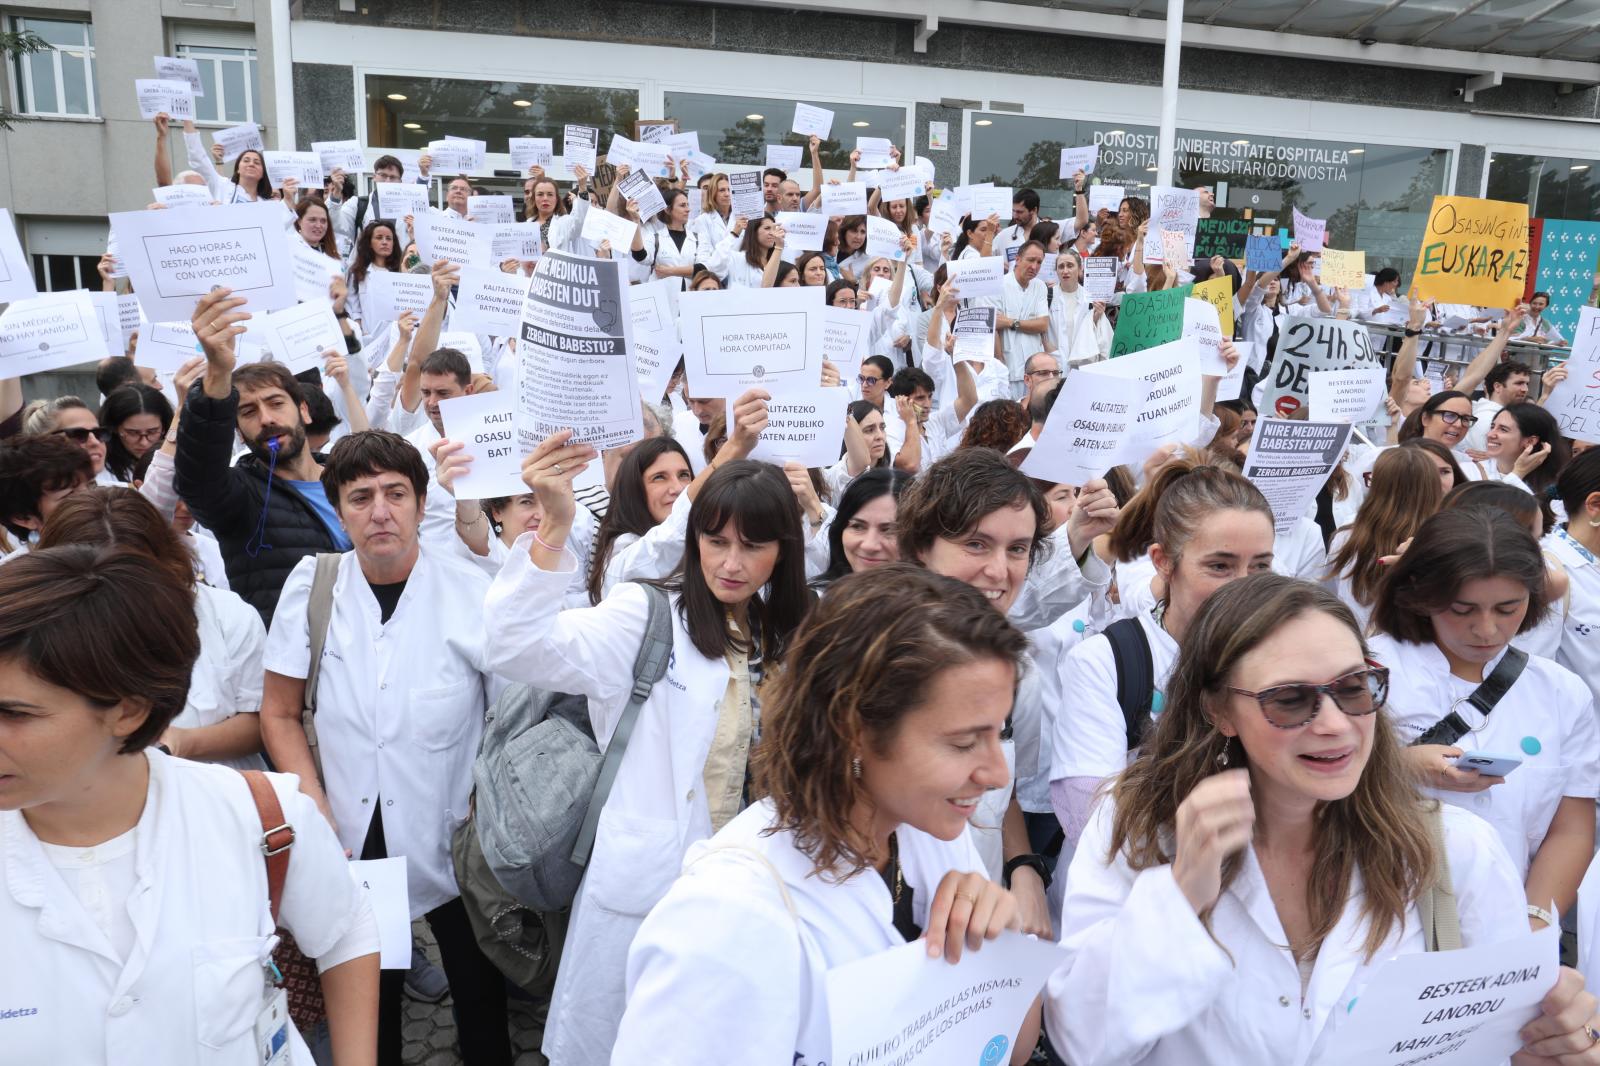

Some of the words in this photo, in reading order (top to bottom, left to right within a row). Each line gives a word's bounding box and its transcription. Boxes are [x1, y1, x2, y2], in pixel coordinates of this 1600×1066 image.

[1093, 130, 1158, 150] DONOSTI
[1276, 147, 1349, 165] OSPITALEA
[1096, 149, 1157, 168] HOSPITA
[1278, 164, 1348, 182] DONOSTIA
[431, 225, 455, 235] BESTEEK
[456, 228, 476, 238] ADINA
[433, 244, 449, 252] NAHI
[438, 236, 467, 245] LANORDU
[169, 245, 197, 256] HAGO
[199, 241, 233, 253] HORAS
[234, 241, 242, 249] A
[160, 258, 199, 270] DESTAJO
[223, 252, 257, 264] PAGAN
[1420, 240, 1527, 283] EUSKARAZ
[175, 270, 197, 281] CON
[197, 265, 248, 280] VOCACIÓN
[548, 259, 599, 286] MEDIKUA
[483, 283, 525, 296] KALITATEZKO
[475, 293, 501, 305] OSASUN
[572, 287, 601, 308] DUT
[479, 304, 500, 313] BATEN
[4, 322, 20, 332] SIN
[22, 313, 65, 329] MÉDICOS
[0, 335, 15, 345] NO
[16, 330, 35, 341] HAY
[37, 323, 79, 337] SANIDAD
[526, 326, 559, 349] ZERGATIK
[559, 336, 615, 353] BABESTU?
[722, 333, 744, 342] HORA
[745, 331, 788, 342] TRABAJADA
[720, 344, 742, 353] HORA
[743, 343, 791, 353] COMPUTADA
[1282, 322, 1347, 360] 24h
[1352, 329, 1379, 363] SO
[1328, 379, 1355, 387] BESTEEK
[1355, 378, 1372, 386] ADINA
[766, 404, 817, 414] ALITATEZKO
[787, 419, 825, 428] PUBLIKO
[1073, 419, 1106, 432] OSASUN
[1263, 423, 1291, 437] NIRE
[1291, 425, 1338, 438] MEDIKUA
[1559, 413, 1587, 433] DEL
[583, 425, 606, 437] 3AN
[787, 433, 816, 441] ALDE!!
[1073, 437, 1101, 450] BATEN
[1260, 437, 1313, 450] BABESTEN
[1313, 439, 1335, 450] DUT
[487, 446, 512, 458] BAT
[1255, 467, 1292, 477] ZERGATIK
[1291, 466, 1327, 476] BABESTU?
[1417, 978, 1488, 1001] BESTEEK
[1489, 965, 1542, 989] ADINA
[1421, 997, 1506, 1025] LANORDU
[848, 1036, 900, 1066] QUIERO
[899, 998, 951, 1044] TRABAJAR
[951, 987, 971, 1009] LAS
[971, 976, 1023, 998] MISMAS
[915, 1029, 935, 1056] QUE
[934, 1015, 954, 1039] LOS
[954, 996, 993, 1025] DEMÁS
[1389, 1034, 1438, 1054] NAHI
